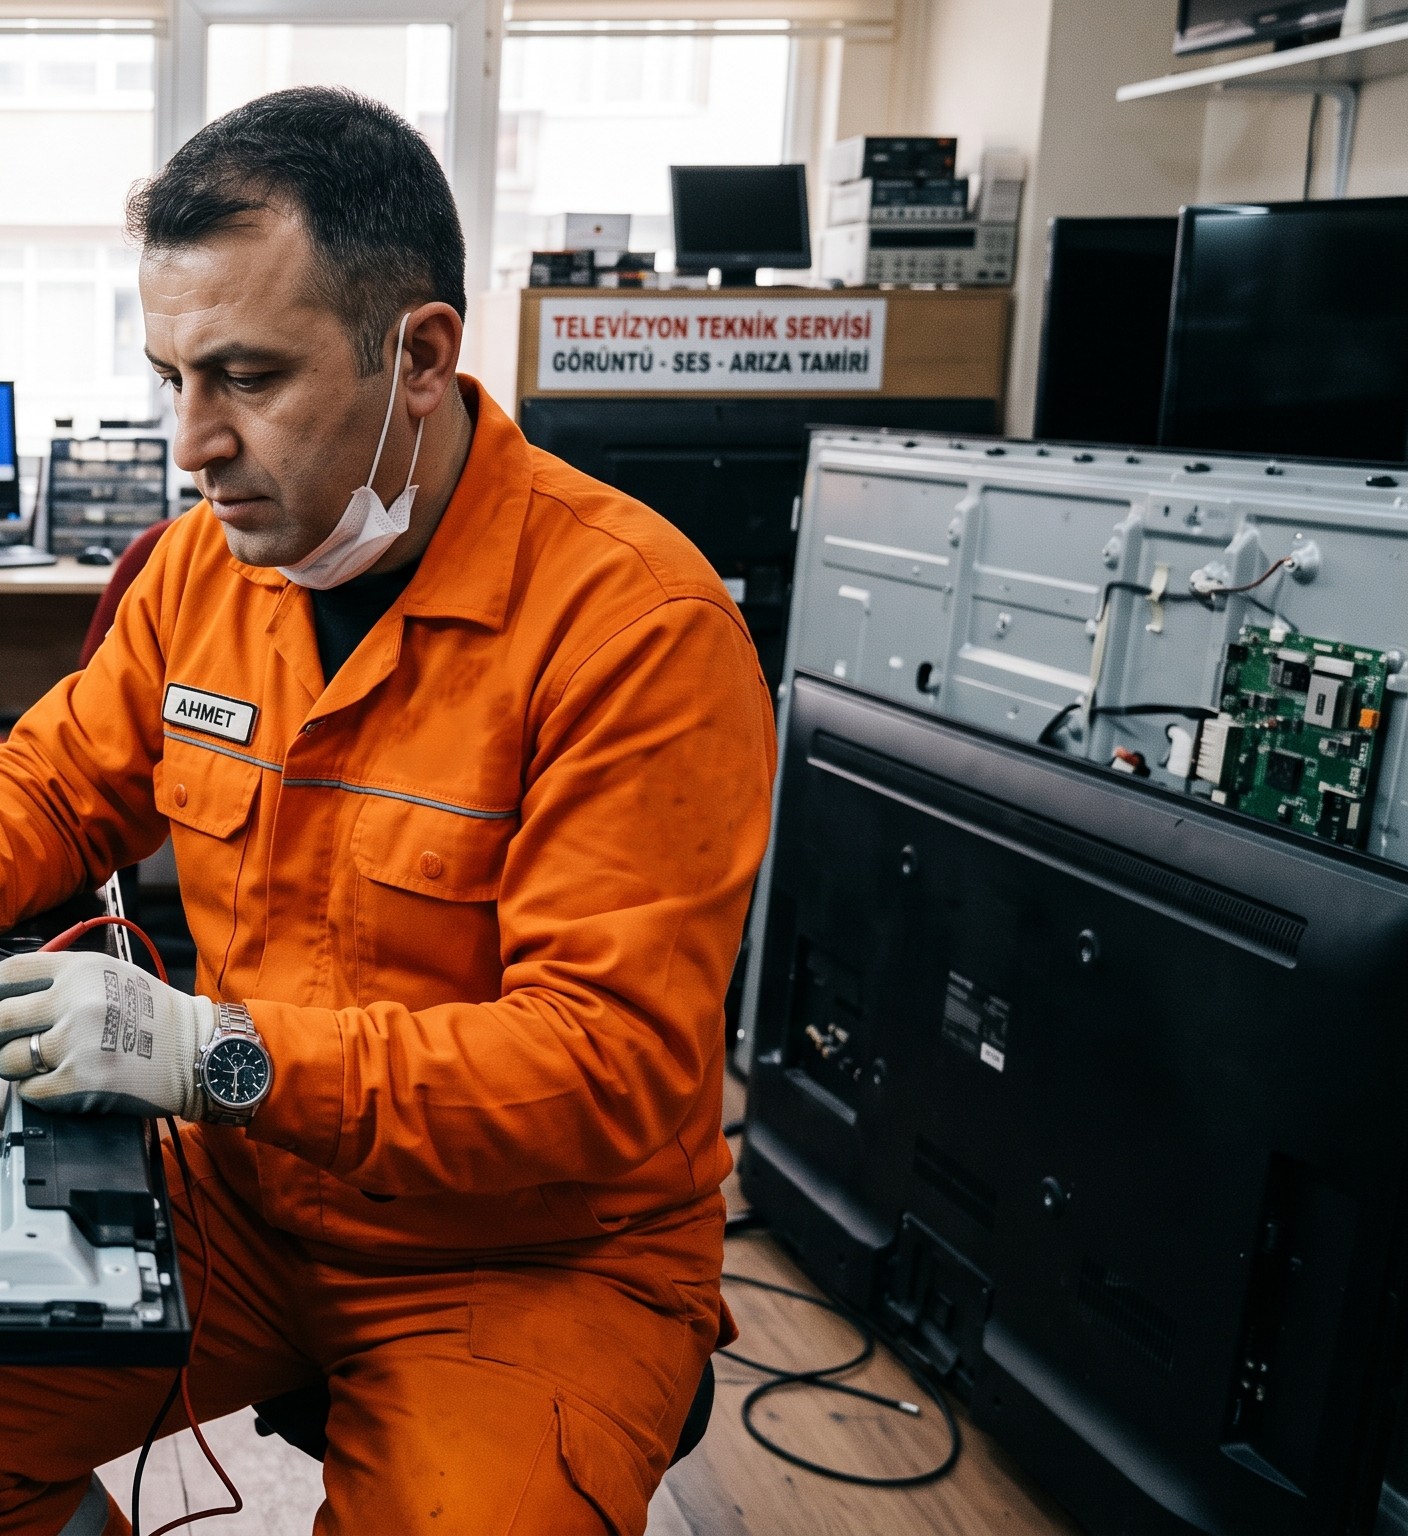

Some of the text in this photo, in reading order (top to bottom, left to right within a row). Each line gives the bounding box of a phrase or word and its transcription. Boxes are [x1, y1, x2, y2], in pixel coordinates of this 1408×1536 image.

[553, 309, 872, 340] TELEVİZYON TEKNİK SERVİSİ
[553, 345, 653, 373] GÖRÜNTÜ
[672, 351, 711, 373] SES
[729, 352, 792, 373] ARIZA
[800, 345, 870, 373] TAMİRİ
[175, 698, 236, 728] AHMET
